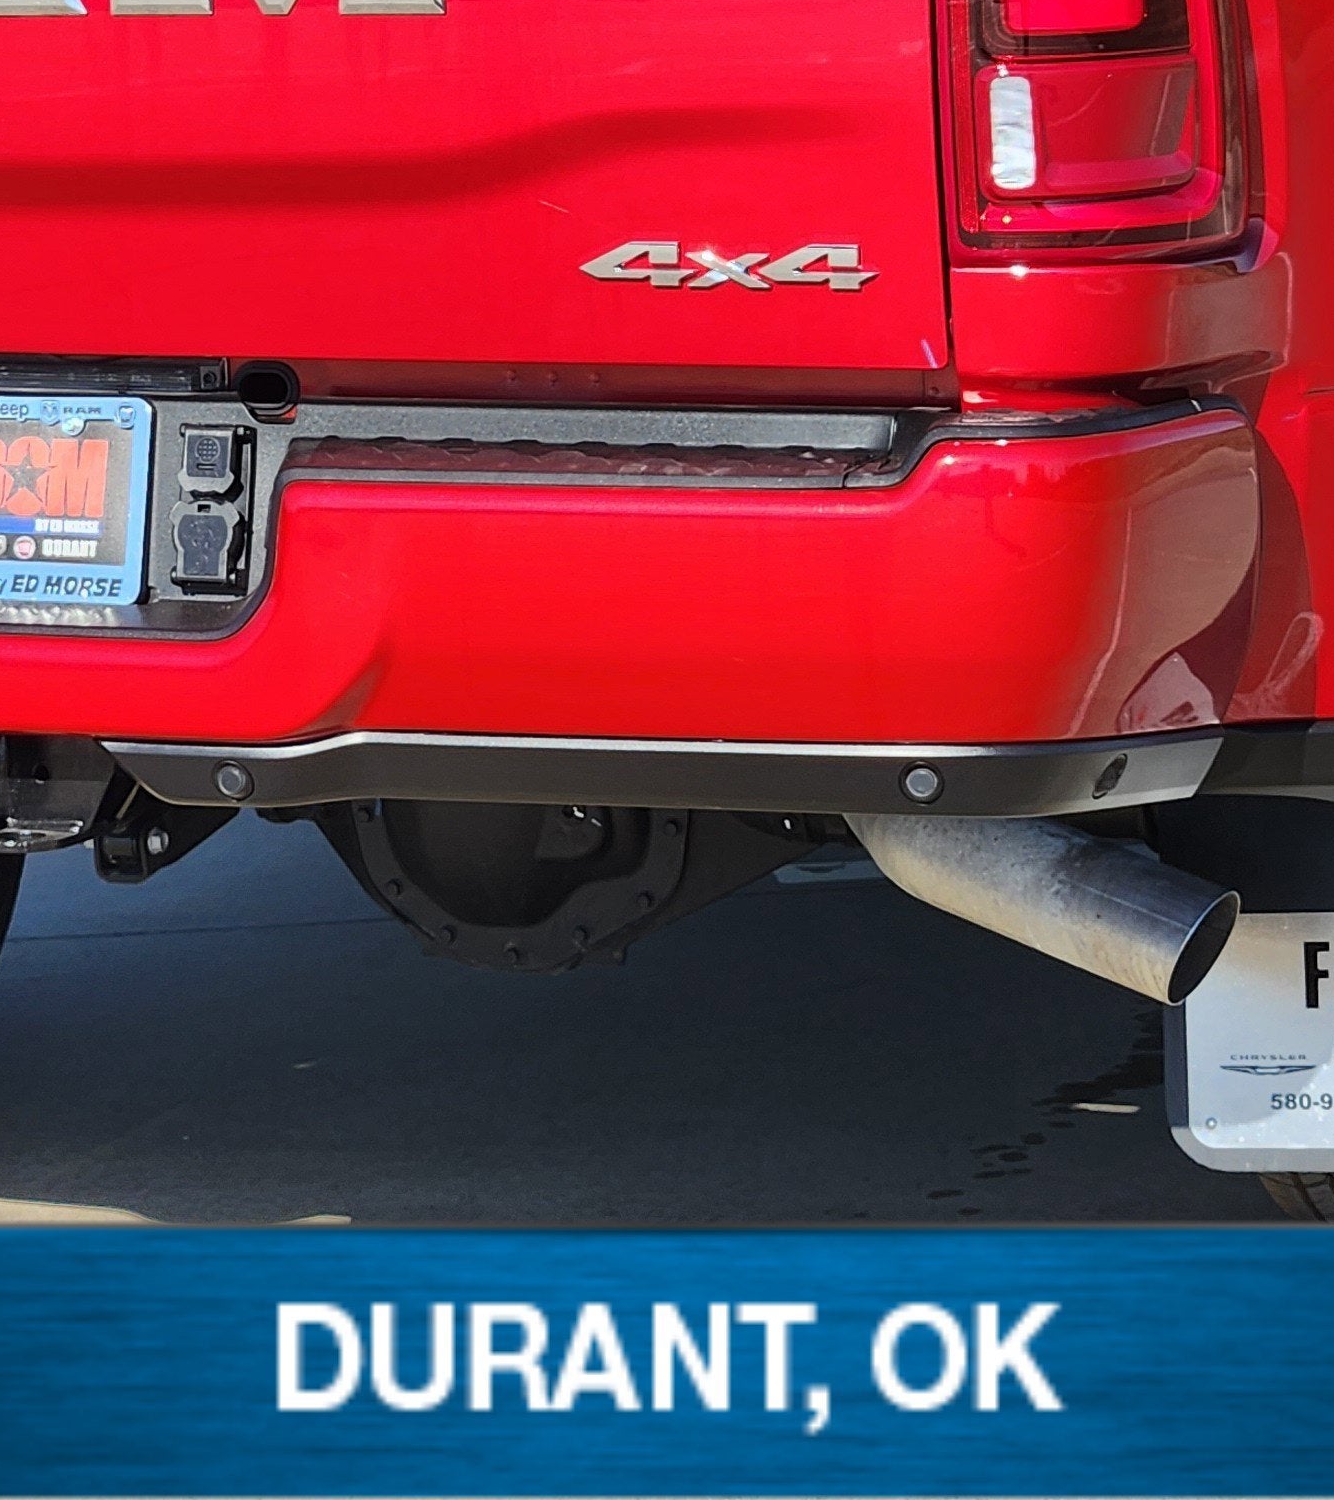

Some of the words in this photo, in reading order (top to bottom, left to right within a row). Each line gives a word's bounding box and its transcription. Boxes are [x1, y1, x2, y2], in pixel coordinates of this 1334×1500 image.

[577, 240, 881, 291] 4x4
[42, 538, 99, 558] DURANT
[11, 574, 40, 594] ED
[43, 574, 123, 599] MORSE
